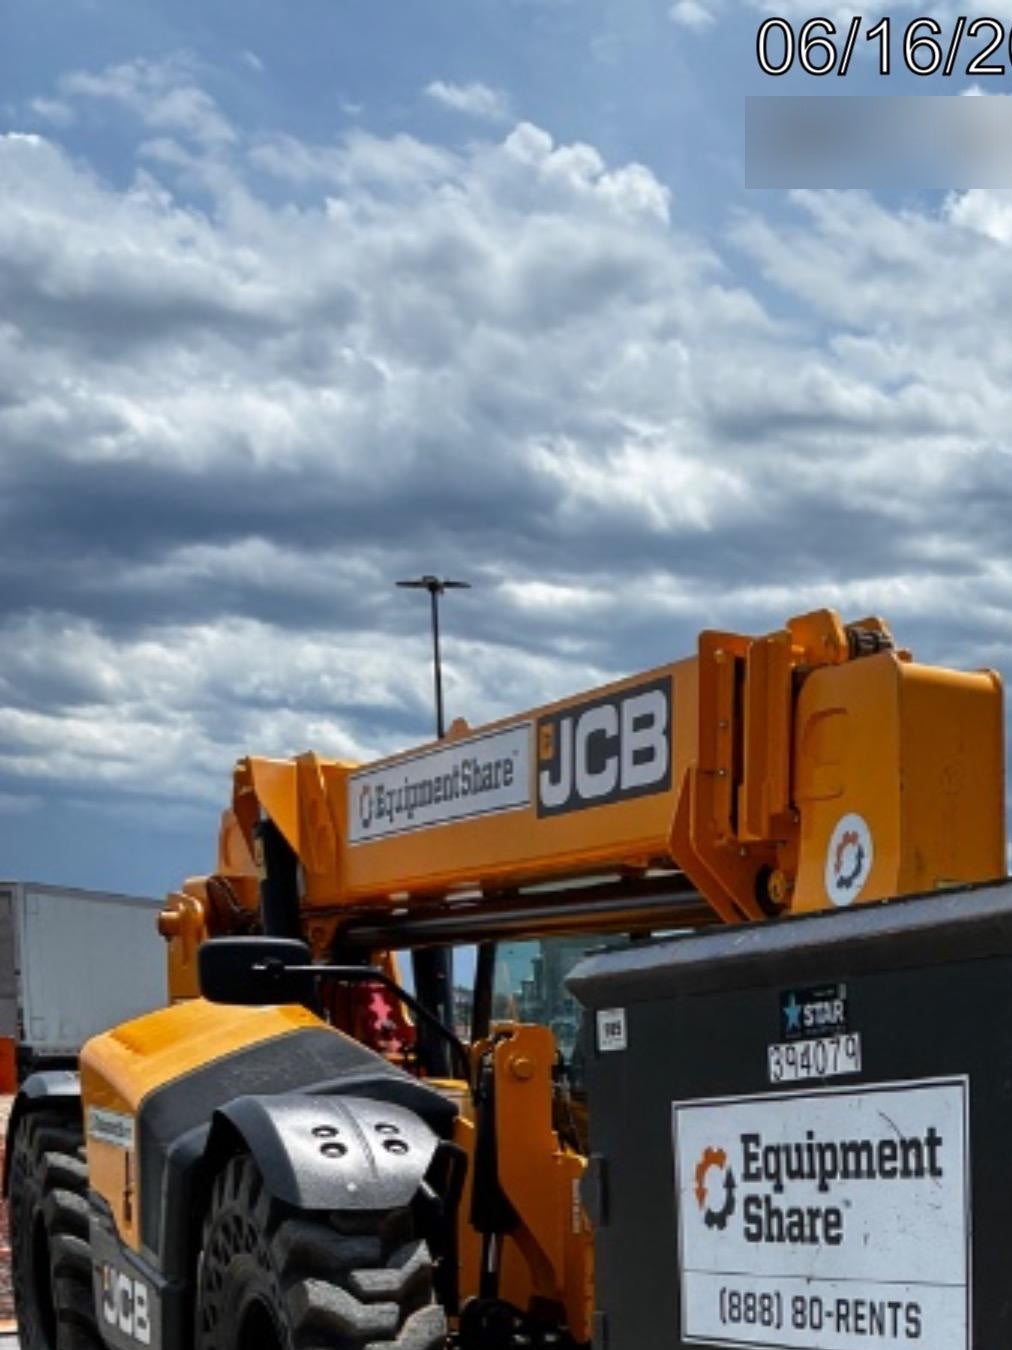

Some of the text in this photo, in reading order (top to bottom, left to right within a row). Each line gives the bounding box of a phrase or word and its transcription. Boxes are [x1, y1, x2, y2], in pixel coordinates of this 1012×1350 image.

[540, 689, 668, 808] JCB
[374, 757, 515, 823] EquipmentShare
[803, 1000, 844, 1027] STAR
[769, 1034, 861, 1082] 394079
[740, 1127, 943, 1193] Equipment
[743, 1194, 843, 1246] Share
[103, 1265, 151, 1345] JCB
[719, 1286, 922, 1339] (888) 80-RENTS
